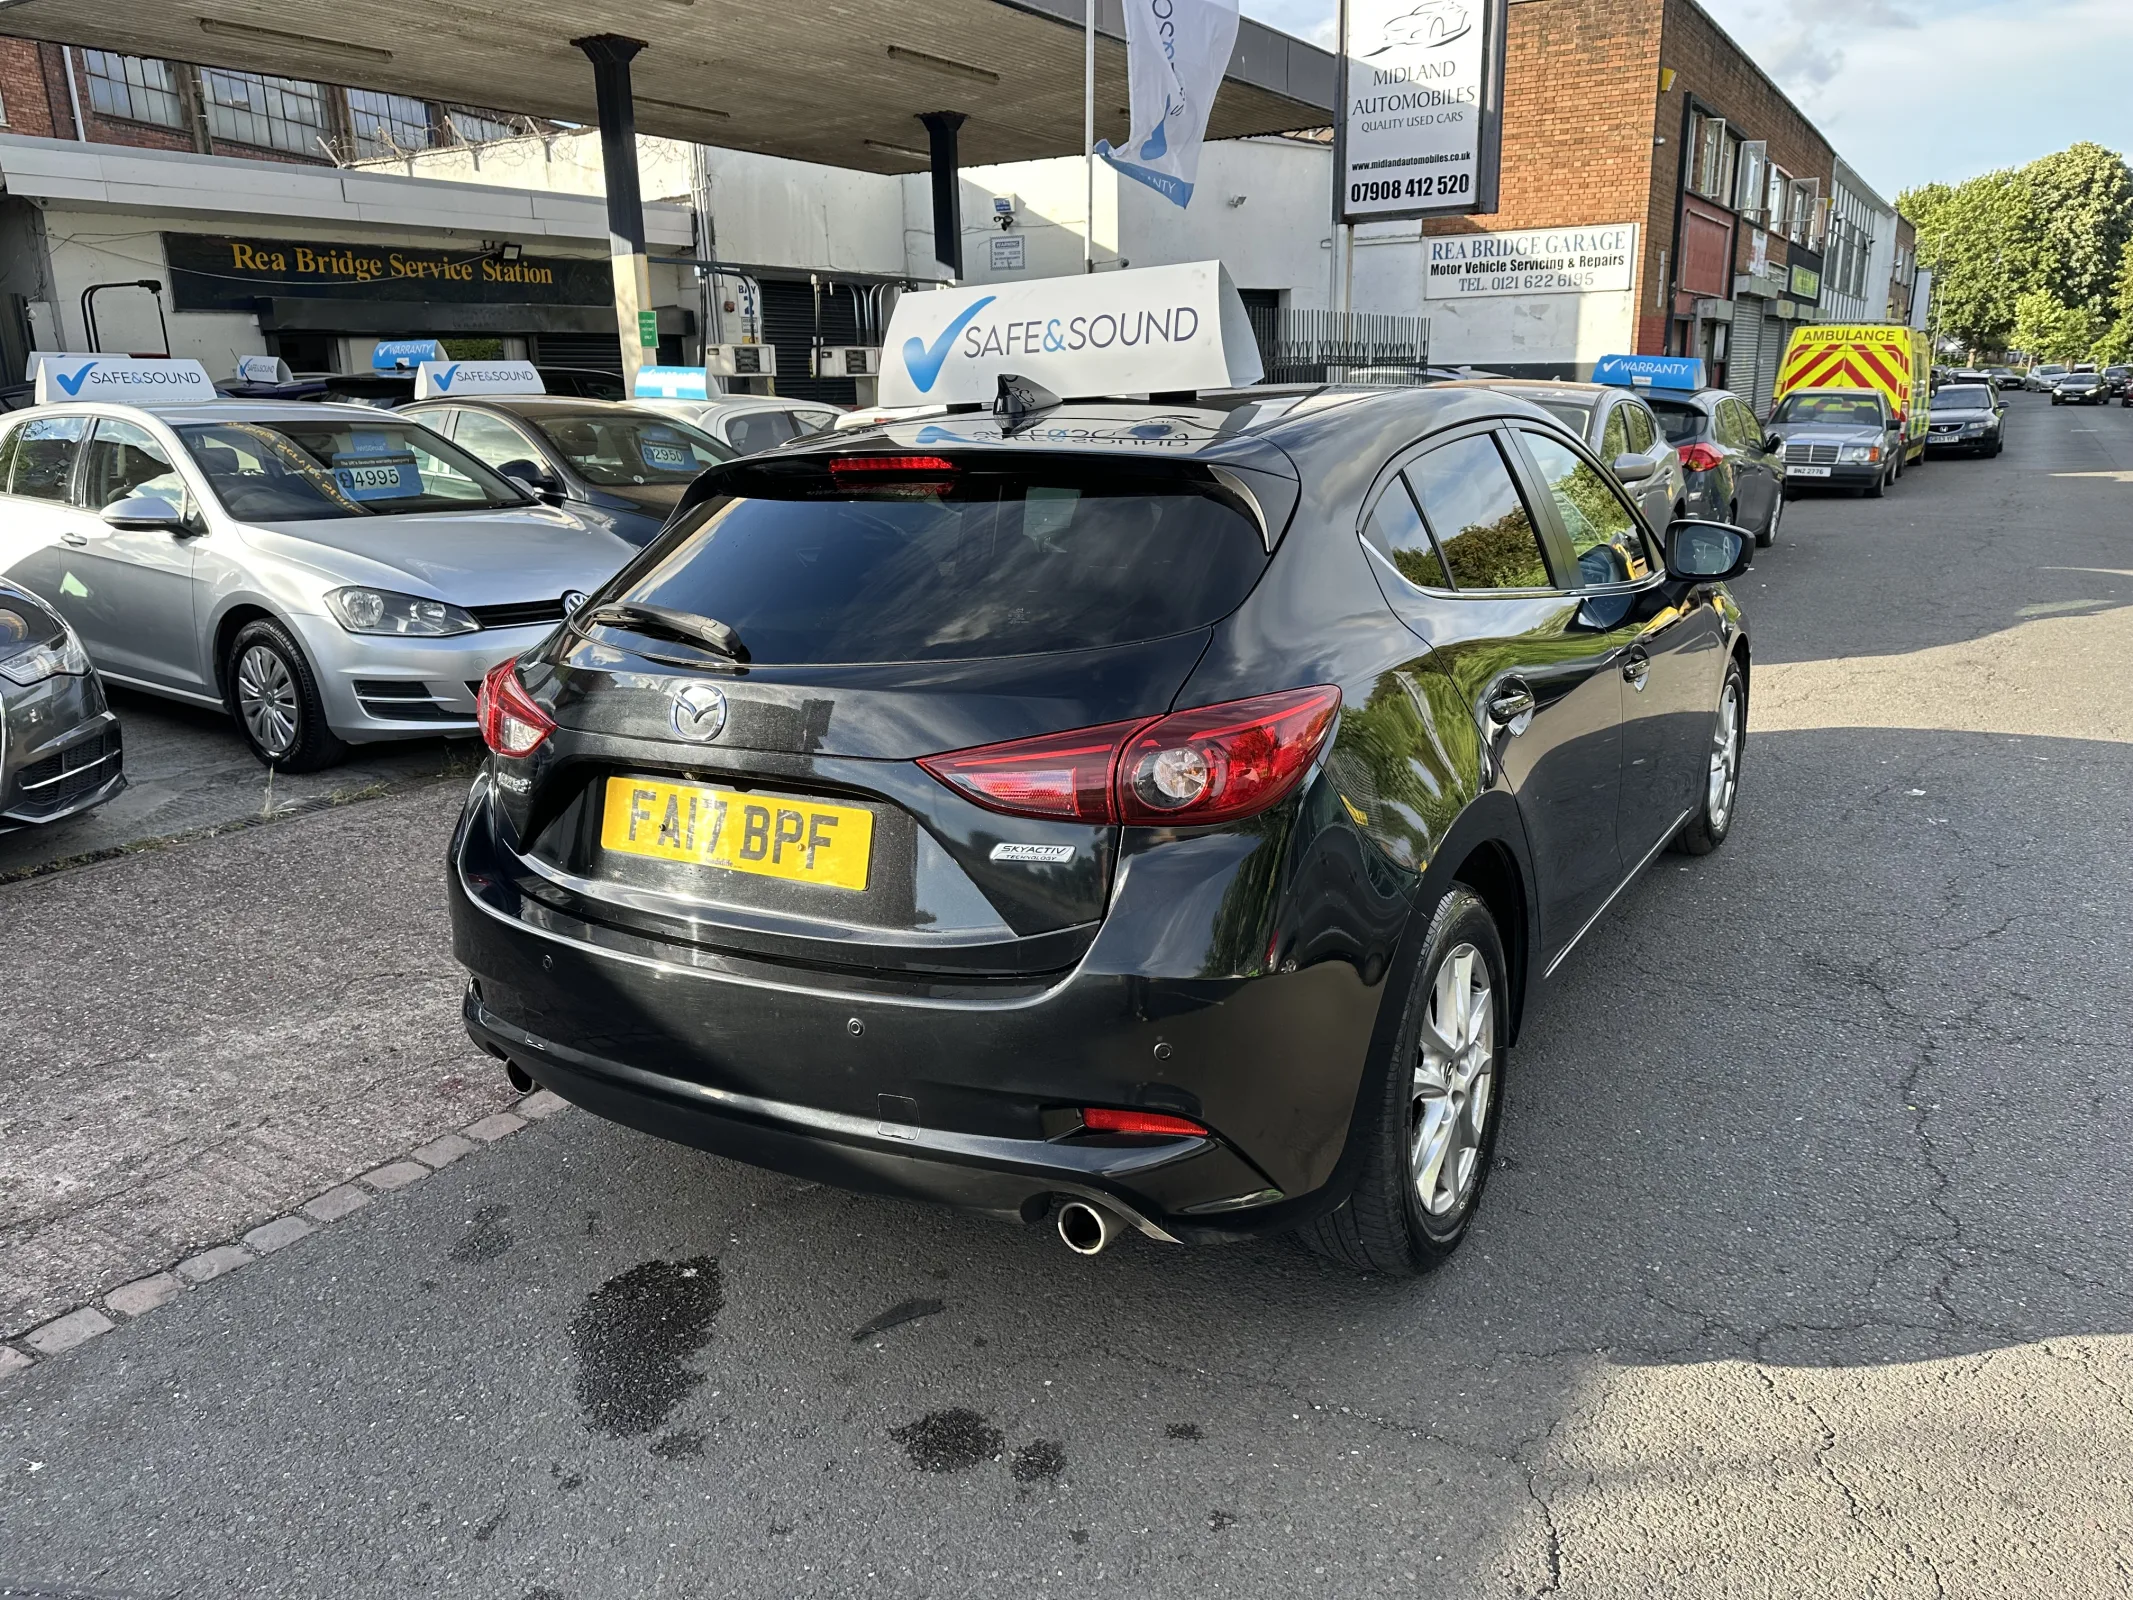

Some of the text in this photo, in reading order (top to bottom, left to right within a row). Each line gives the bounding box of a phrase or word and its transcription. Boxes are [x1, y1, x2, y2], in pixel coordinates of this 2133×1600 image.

[1373, 60, 1456, 86] MIDLAND
[1352, 85, 1476, 115] AUTOMOBILES
[1361, 111, 1464, 133] QUALITY USED CARS
[1352, 151, 1471, 171] www.midlandautomobiles.co.uk
[1351, 173, 1470, 202] 07908 412 520
[1432, 231, 1626, 261] REA BRIDGE GARAGE
[230, 243, 553, 284] Rea Bridge Service Station
[1430, 254, 1625, 276] Motor Vehicle Servicing & Repairs
[1458, 271, 1595, 291] TEL. 0121 622 6195
[963, 307, 1199, 358] SAFE&SOUND
[1802, 330, 1896, 341] AMBULANCE
[389, 343, 432, 355] WARRANTY
[90, 371, 201, 384] SAFE&SOUND
[455, 371, 534, 382] SAFE&SOUND
[1620, 361, 1689, 375] WARRANTY
[628, 788, 839, 870] FA17 BPF
[1001, 845, 1067, 854] SKYACTIV
